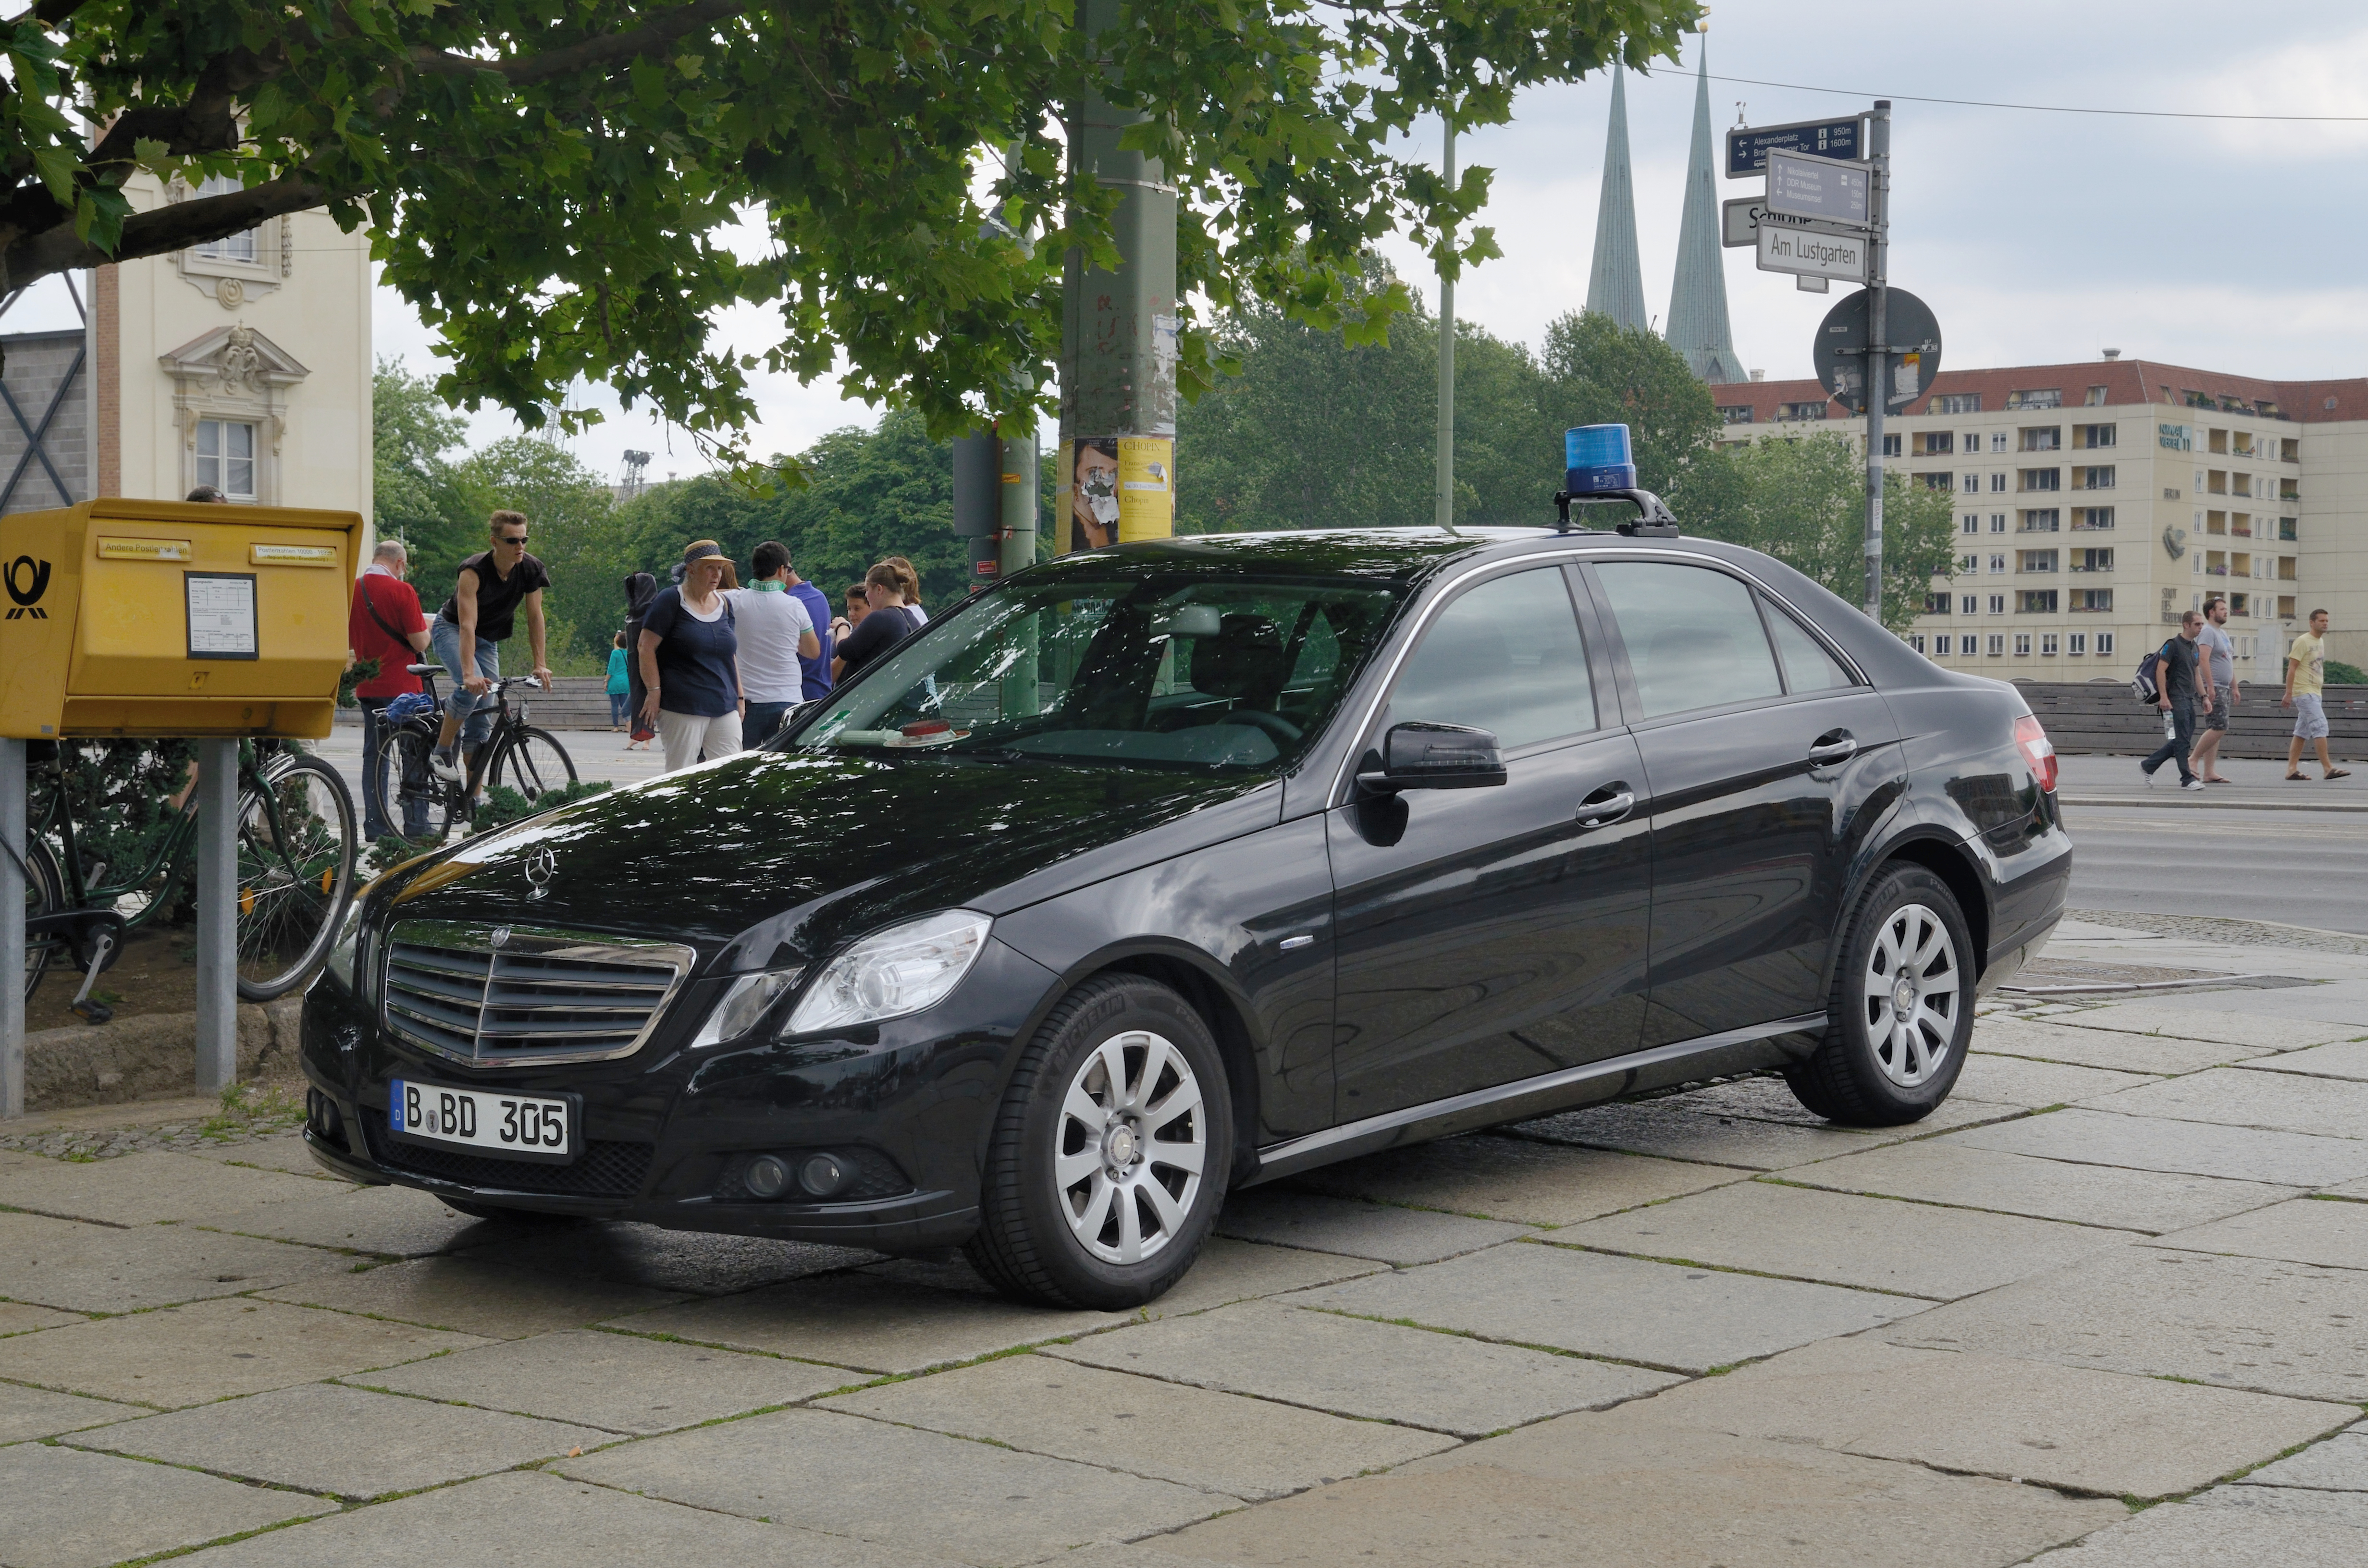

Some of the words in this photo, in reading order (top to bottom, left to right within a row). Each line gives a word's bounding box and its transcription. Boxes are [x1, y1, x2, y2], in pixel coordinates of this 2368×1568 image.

[1754, 134, 1799, 146] Alexanderplatz
[1834, 127, 1851, 136] 950m
[1800, 143, 1810, 151] Tor
[1830, 138, 1851, 147] 1600m
[1787, 166, 1819, 180] Nikolaiviertel
[1851, 178, 1863, 187] 450m
[1787, 178, 1799, 188] DDR
[1801, 180, 1822, 191] Museum
[1851, 190, 1862, 199] 150m
[1787, 190, 1822, 203] Museumsinsel
[1850, 201, 1862, 210] 250m
[1771, 233, 1791, 257] Am
[1797, 236, 1855, 267] Lustgarten
[1124, 441, 1160, 452] CHOPIN
[1124, 495, 1149, 505] Chopin
[105, 543, 134, 551] Andere
[136, 544, 187, 554] Postleitzahlen
[2162, 612, 2183, 624] FRIEDEN
[1860, 881, 1897, 945] MICHELIN
[1053, 994, 1122, 1069] MICHELIN
[395, 1109, 401, 1121] D
[407, 1086, 422, 1127] B
[441, 1092, 477, 1138] BD
[500, 1100, 563, 1146] 305
